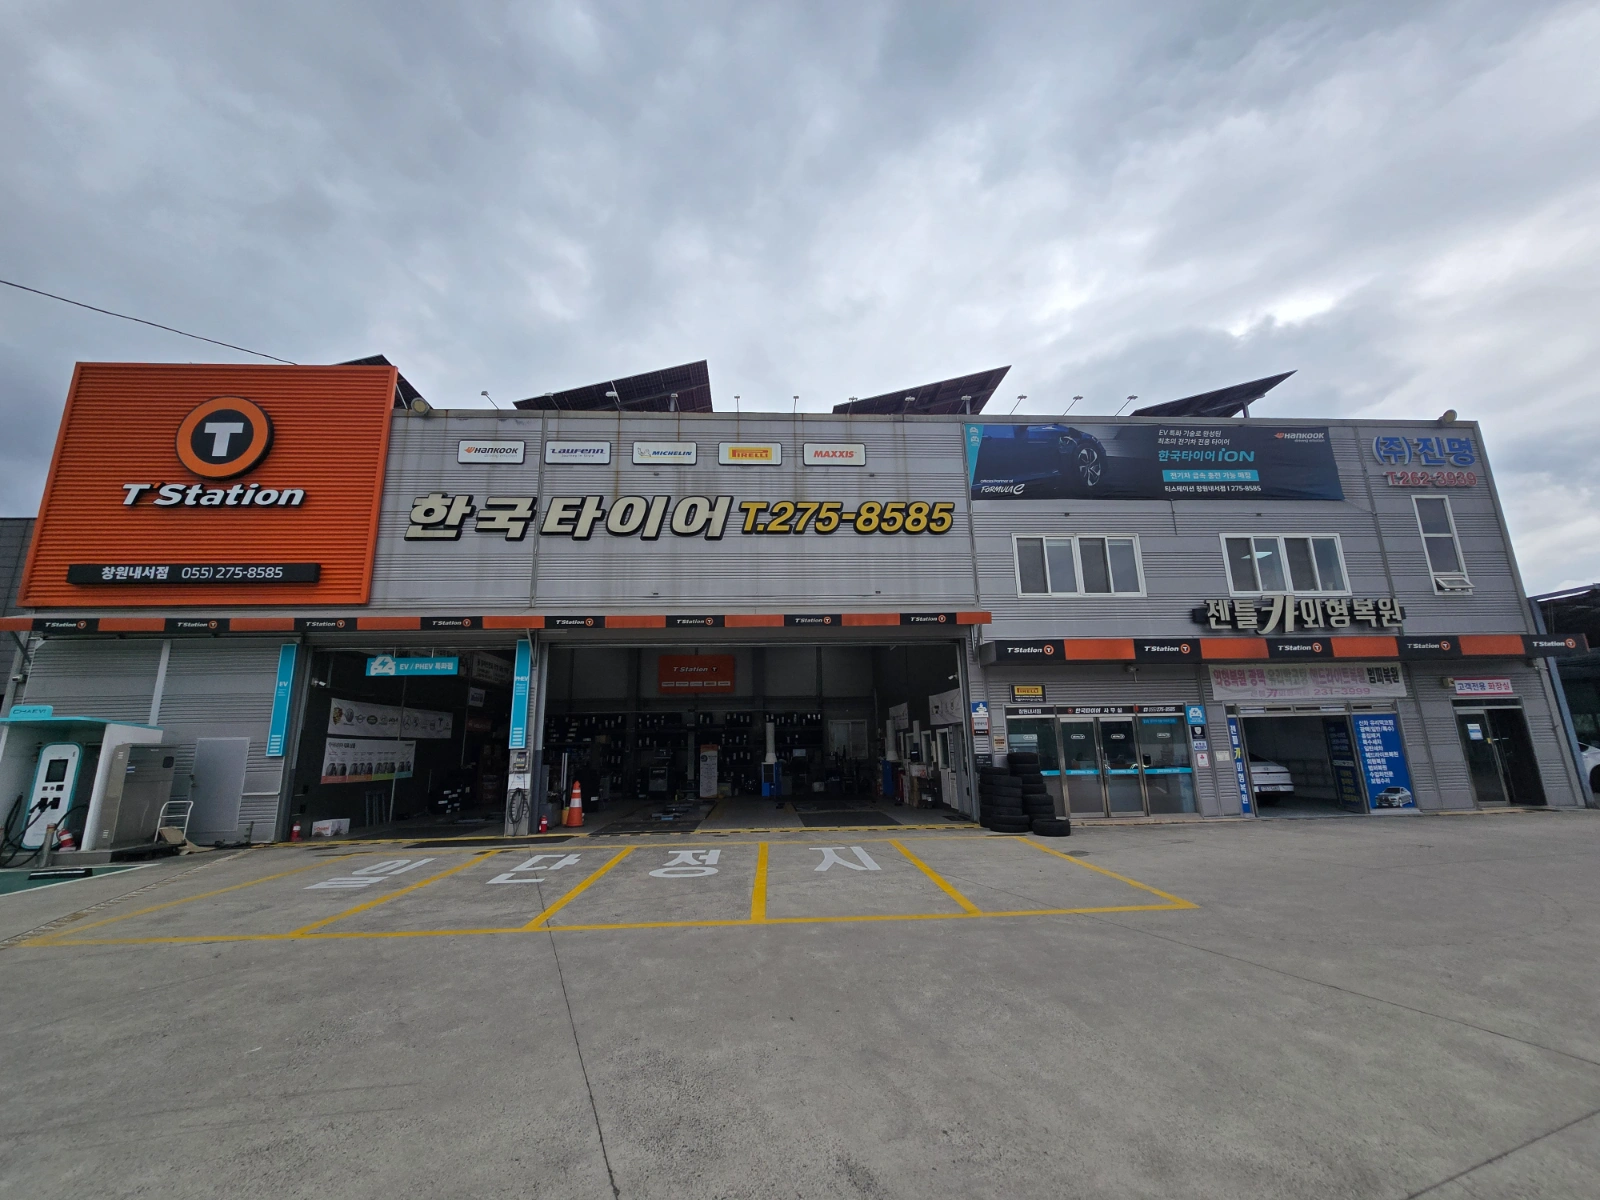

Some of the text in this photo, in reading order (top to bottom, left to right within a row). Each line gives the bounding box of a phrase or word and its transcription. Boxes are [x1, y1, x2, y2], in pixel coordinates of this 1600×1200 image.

[203, 422, 244, 457] T
[474, 446, 519, 454] HANKOOK
[550, 447, 605, 455] Laurenn
[732, 449, 768, 458] PIRELLI
[813, 450, 855, 458] MAXXIS
[1158, 450, 1215, 462] 한국타이어
[1372, 436, 1476, 467] (주)진명
[1382, 471, 1477, 487] T.262-3939
[404, 492, 955, 541] 한국타이어 T.275-8585
[101, 565, 170, 580] 창원내서점
[215, 566, 283, 580] 275-8585
[1366, 666, 1400, 684] 범퍼복원
[1457, 681, 1510, 691] 고객전용 화장실
